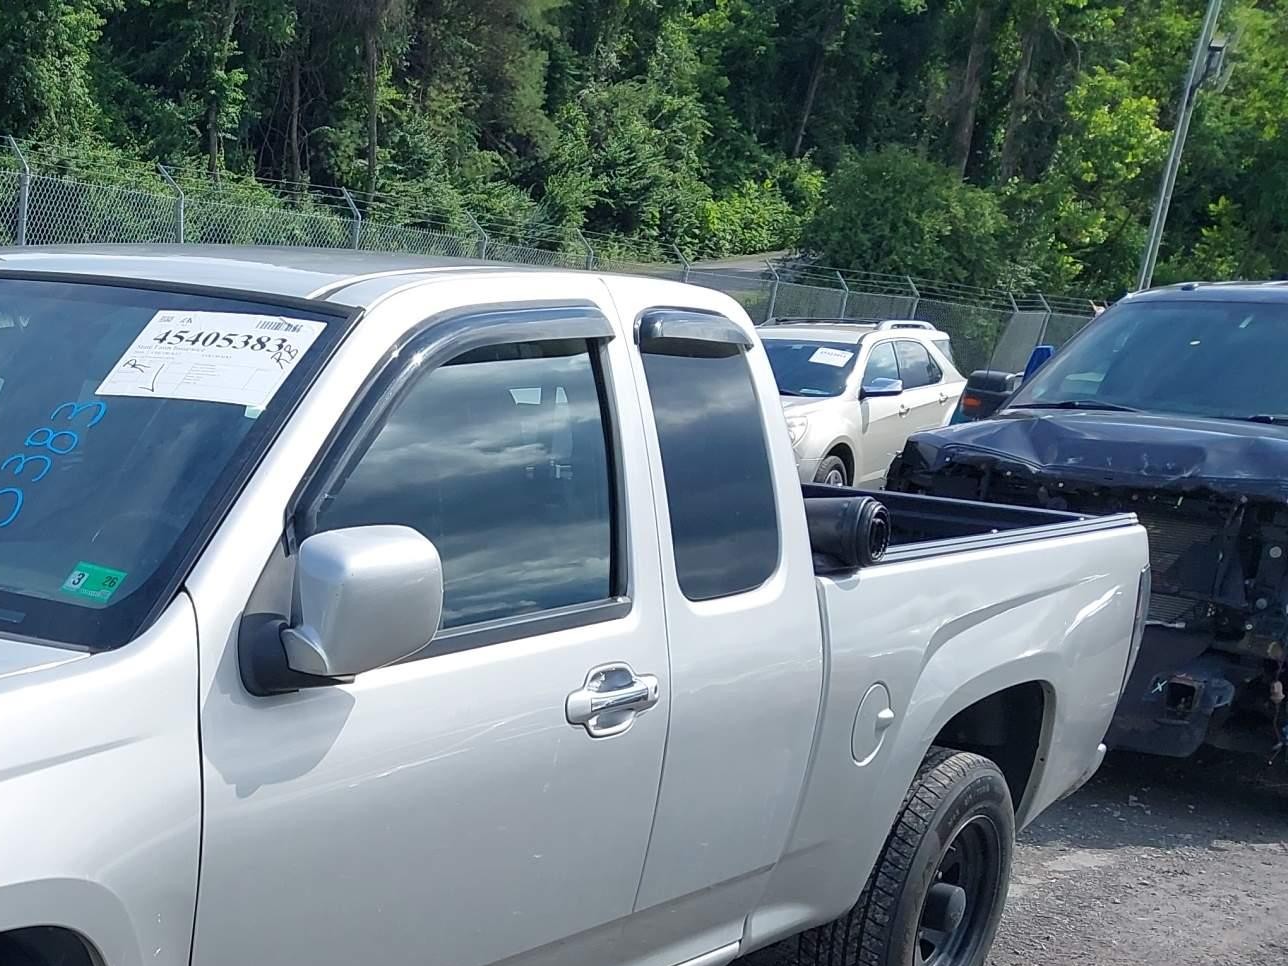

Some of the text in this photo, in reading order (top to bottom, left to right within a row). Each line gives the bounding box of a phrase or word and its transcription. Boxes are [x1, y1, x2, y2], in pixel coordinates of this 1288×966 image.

[153, 329, 288, 353] 45405383
[72, 572, 86, 586] 3
[102, 575, 119, 588] 26
